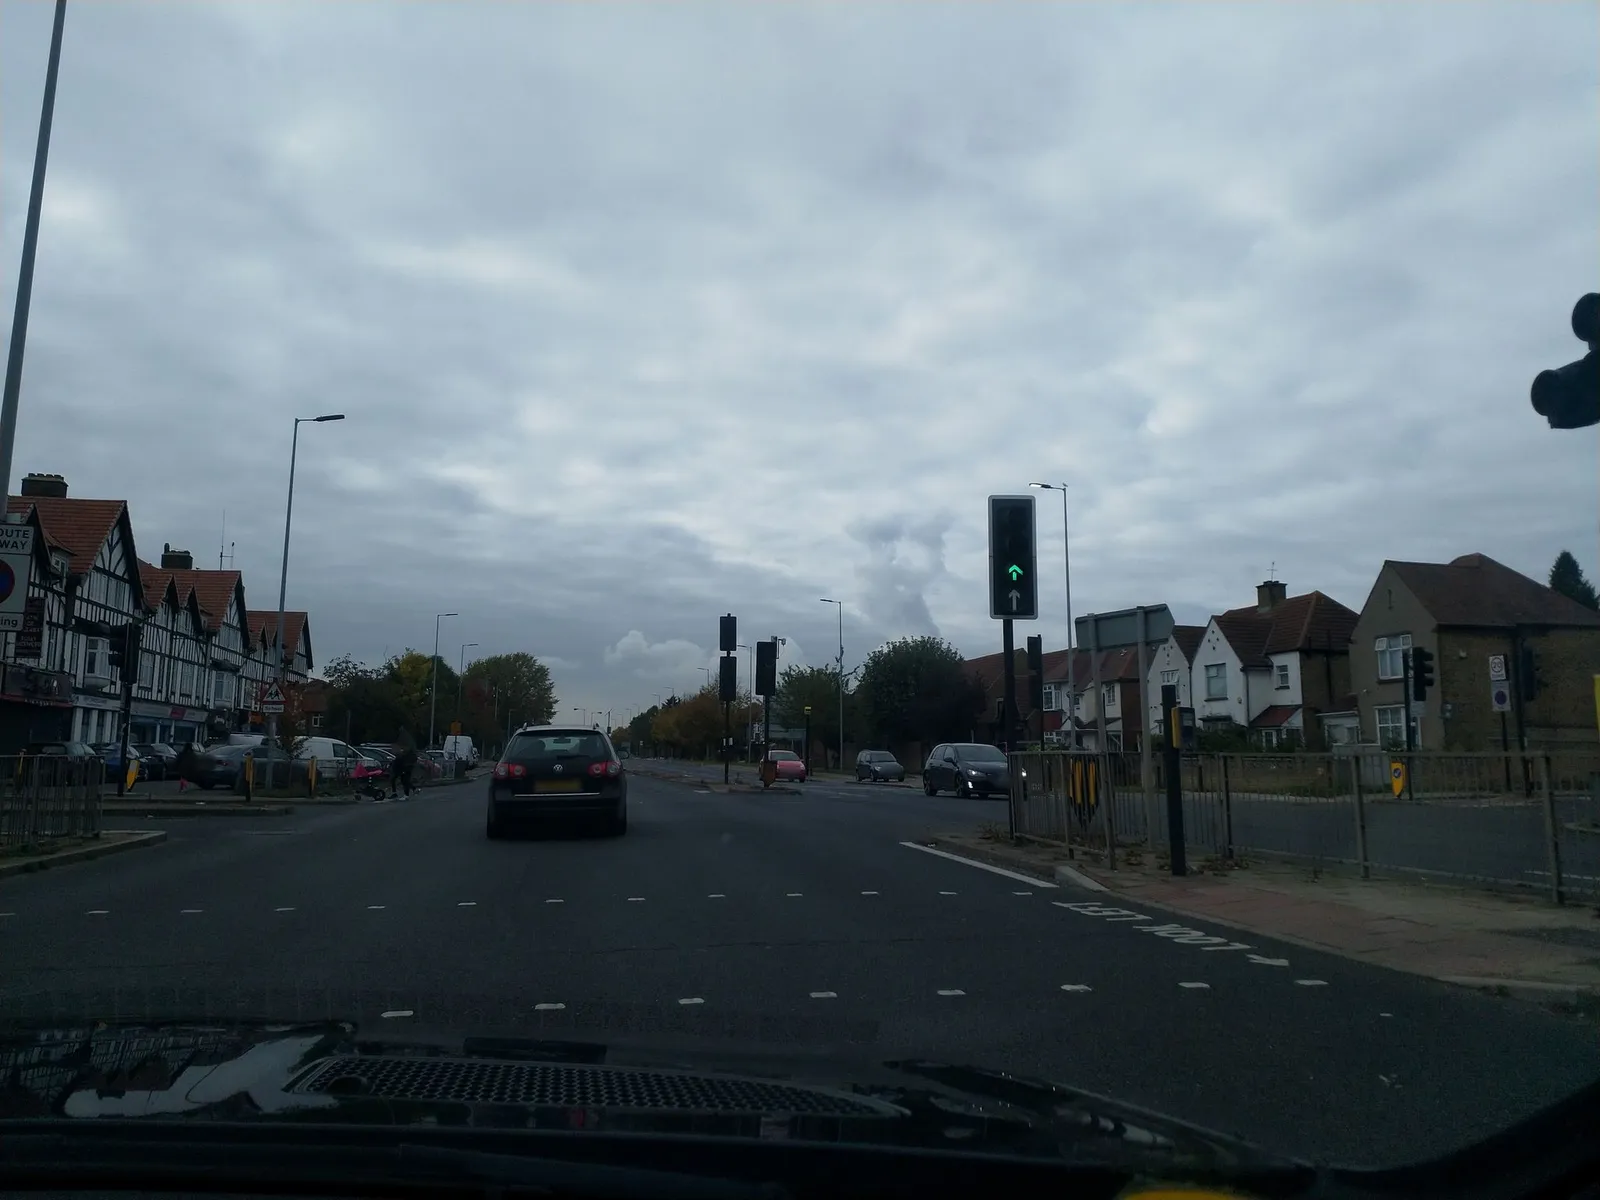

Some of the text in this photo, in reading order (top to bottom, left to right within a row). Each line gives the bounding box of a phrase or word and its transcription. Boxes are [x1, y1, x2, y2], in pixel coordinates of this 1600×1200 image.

[1, 614, 18, 628] ing
[1051, 901, 1256, 951] LOOK LEFT
